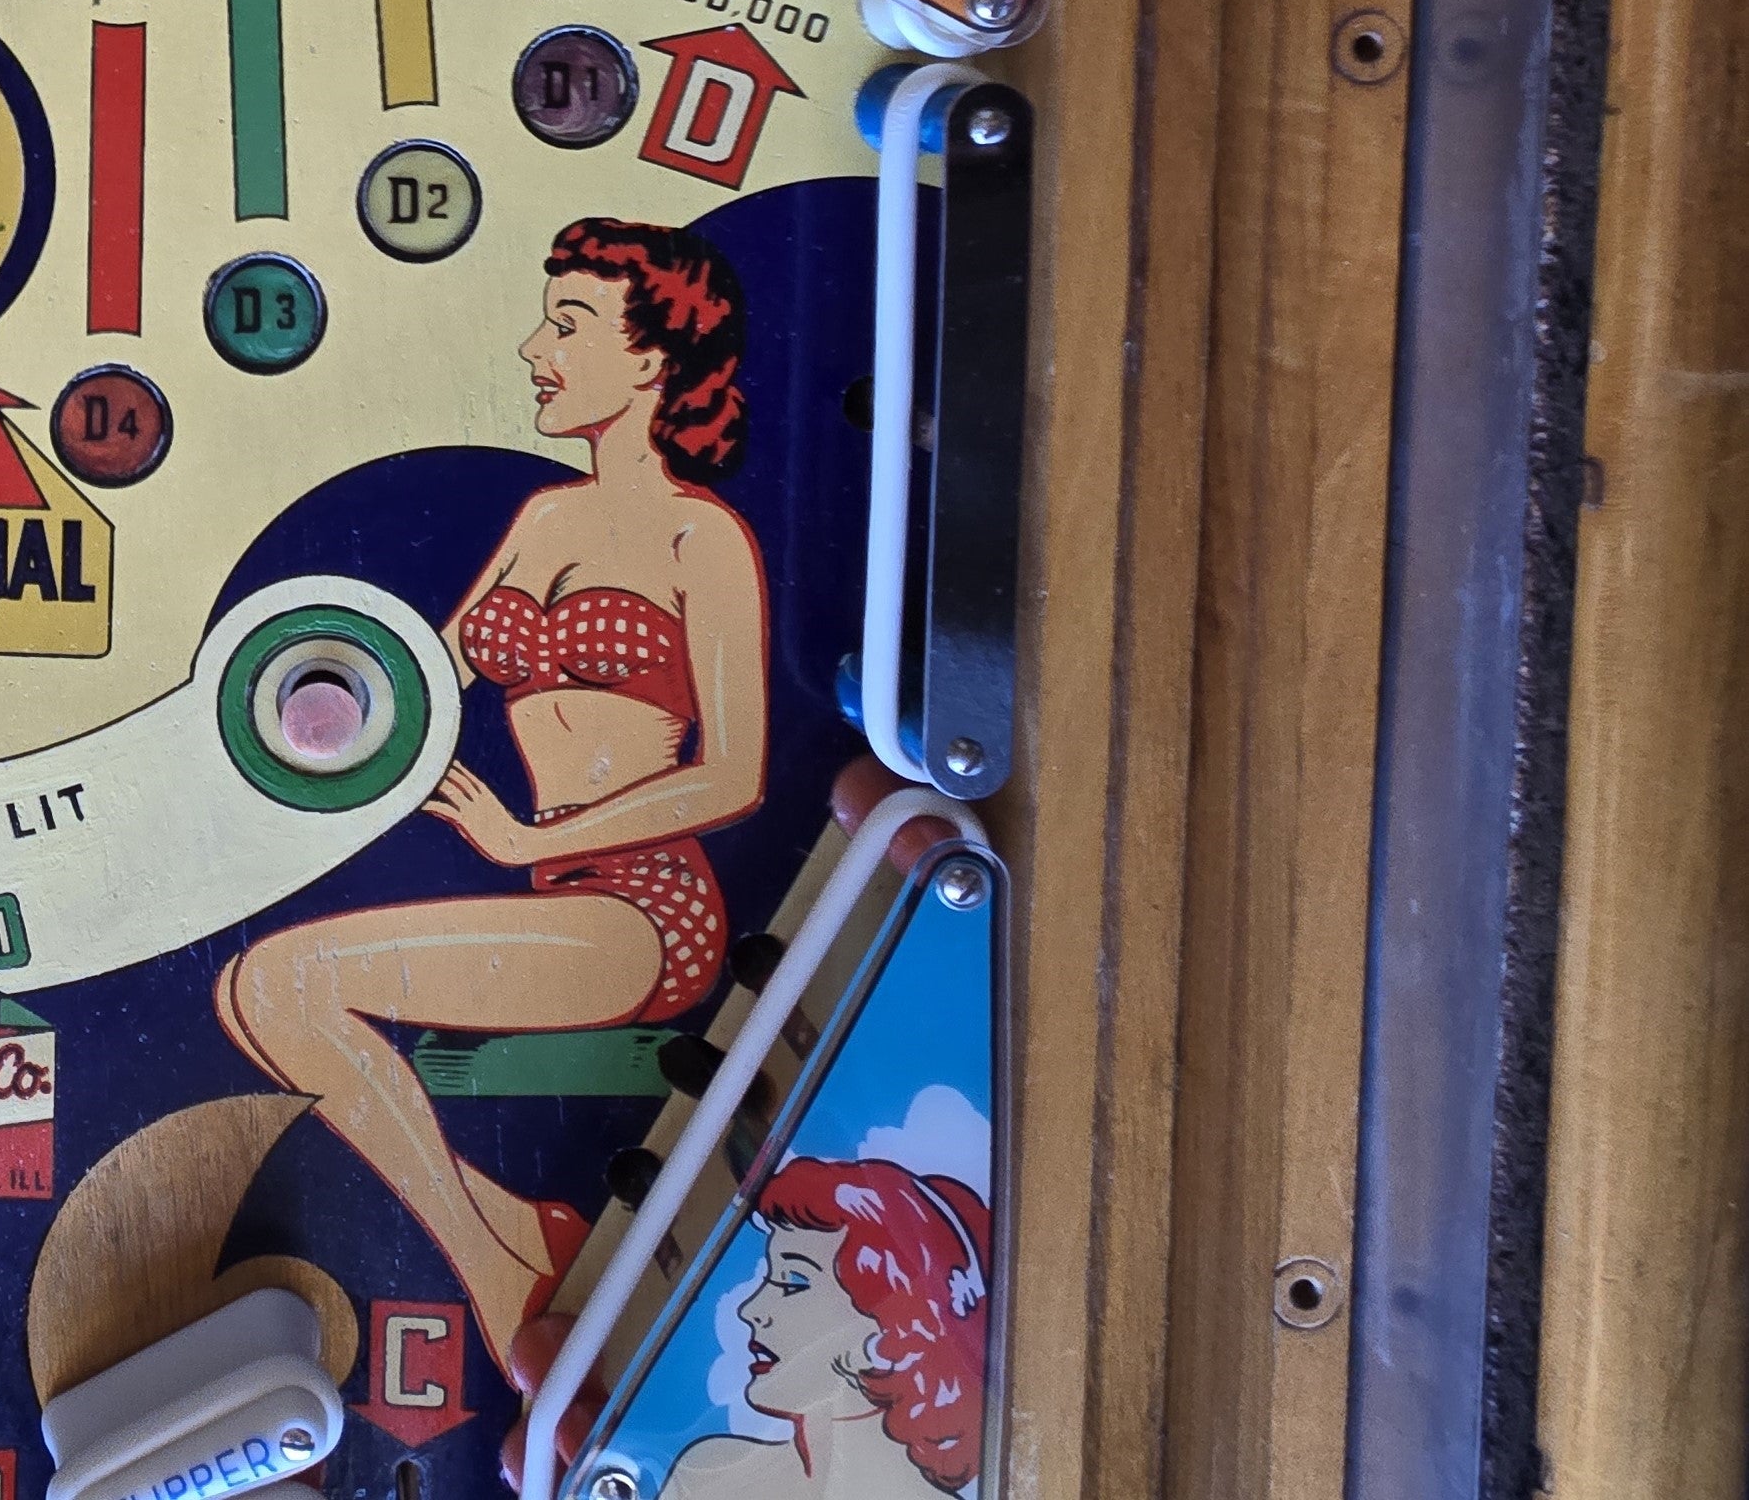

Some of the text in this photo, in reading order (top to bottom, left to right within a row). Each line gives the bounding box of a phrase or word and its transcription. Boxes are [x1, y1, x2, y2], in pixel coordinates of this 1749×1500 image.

[665, 59, 755, 163] D
[6, 783, 85, 839] LIT
[385, 1316, 447, 1406] C
